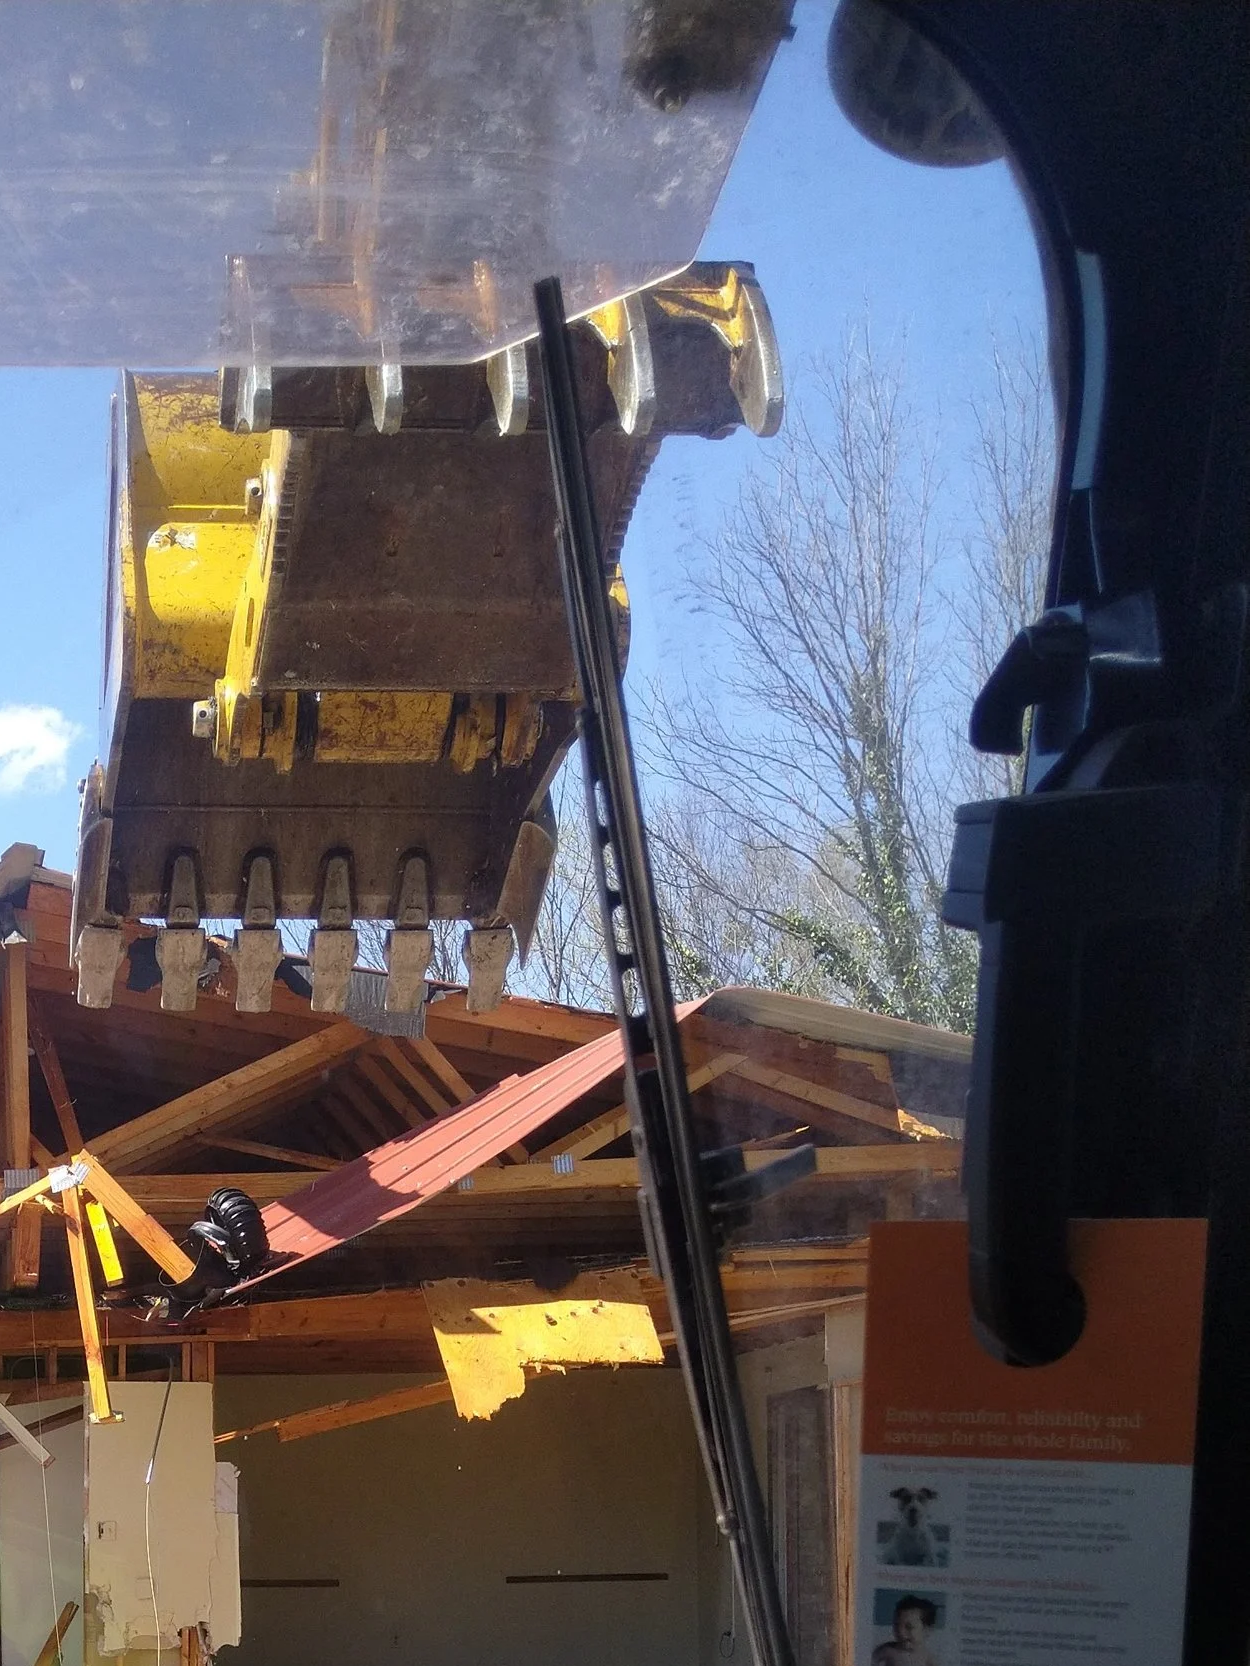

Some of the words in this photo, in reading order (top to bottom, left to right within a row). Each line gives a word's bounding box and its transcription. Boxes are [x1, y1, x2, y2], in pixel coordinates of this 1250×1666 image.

[1016, 1410, 1101, 1430] reliability
[1105, 1412, 1143, 1429] and
[883, 1430, 950, 1447] savings
[952, 1430, 975, 1446] for
[979, 1430, 1008, 1447] the
[1011, 1431, 1067, 1449] whole
[1069, 1433, 1132, 1453] family.
